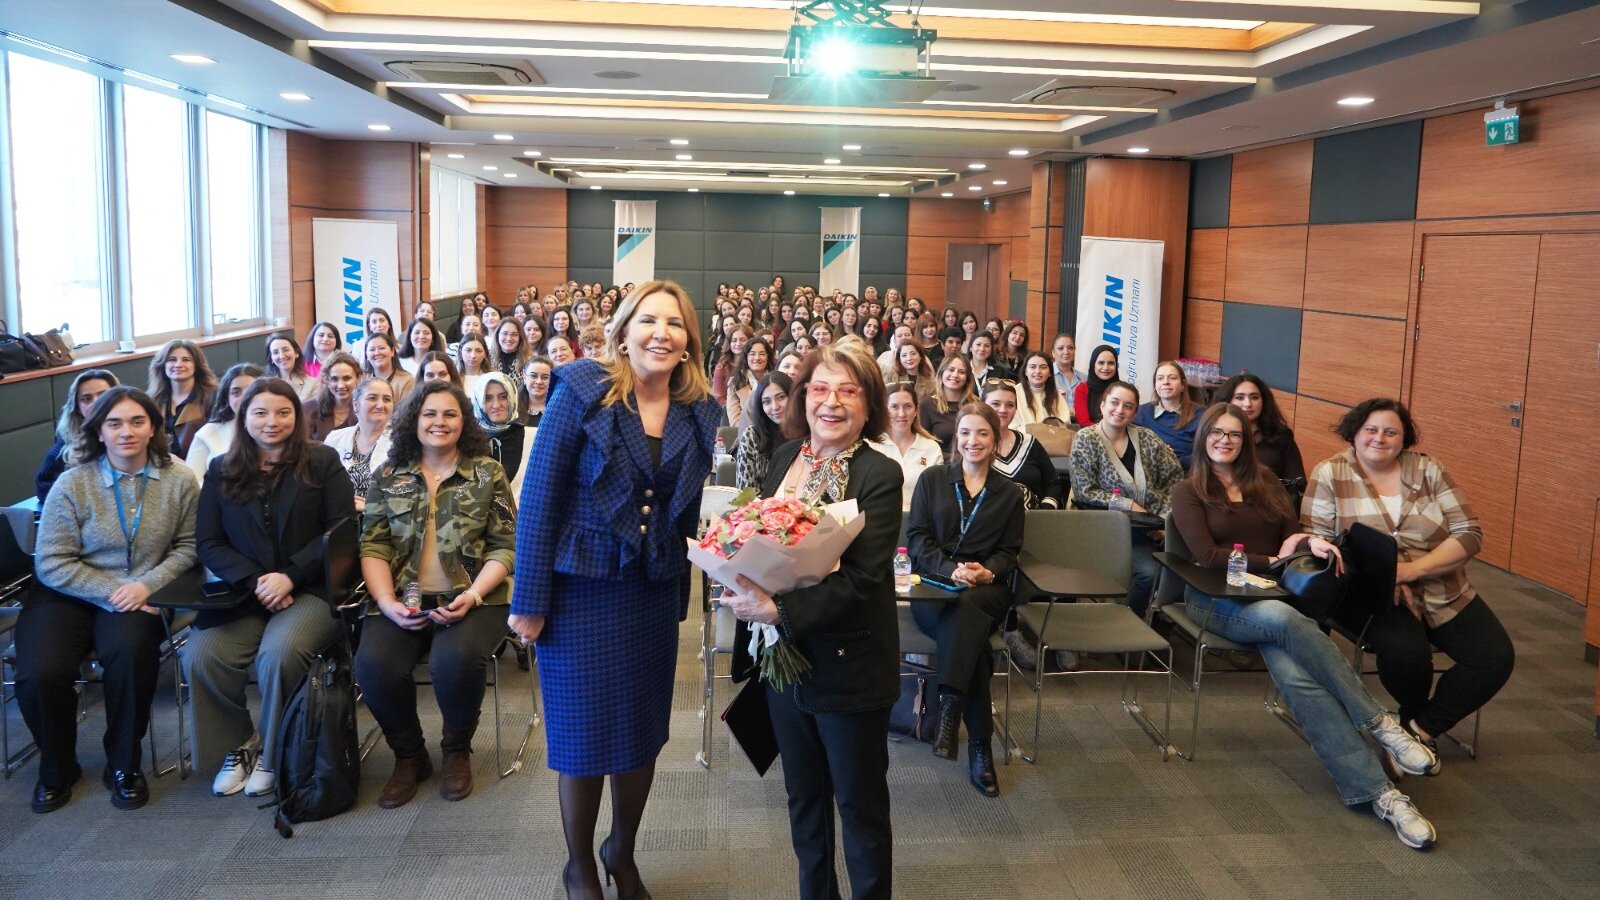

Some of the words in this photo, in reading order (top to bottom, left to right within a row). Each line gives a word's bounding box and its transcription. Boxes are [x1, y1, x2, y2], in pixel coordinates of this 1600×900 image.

[342, 256, 364, 346] AIKIN
[1103, 274, 1124, 368] IKIN
[1129, 278, 1140, 322] Uzmanı
[1128, 325, 1138, 355] Hava
[1126, 357, 1138, 385] oğru
